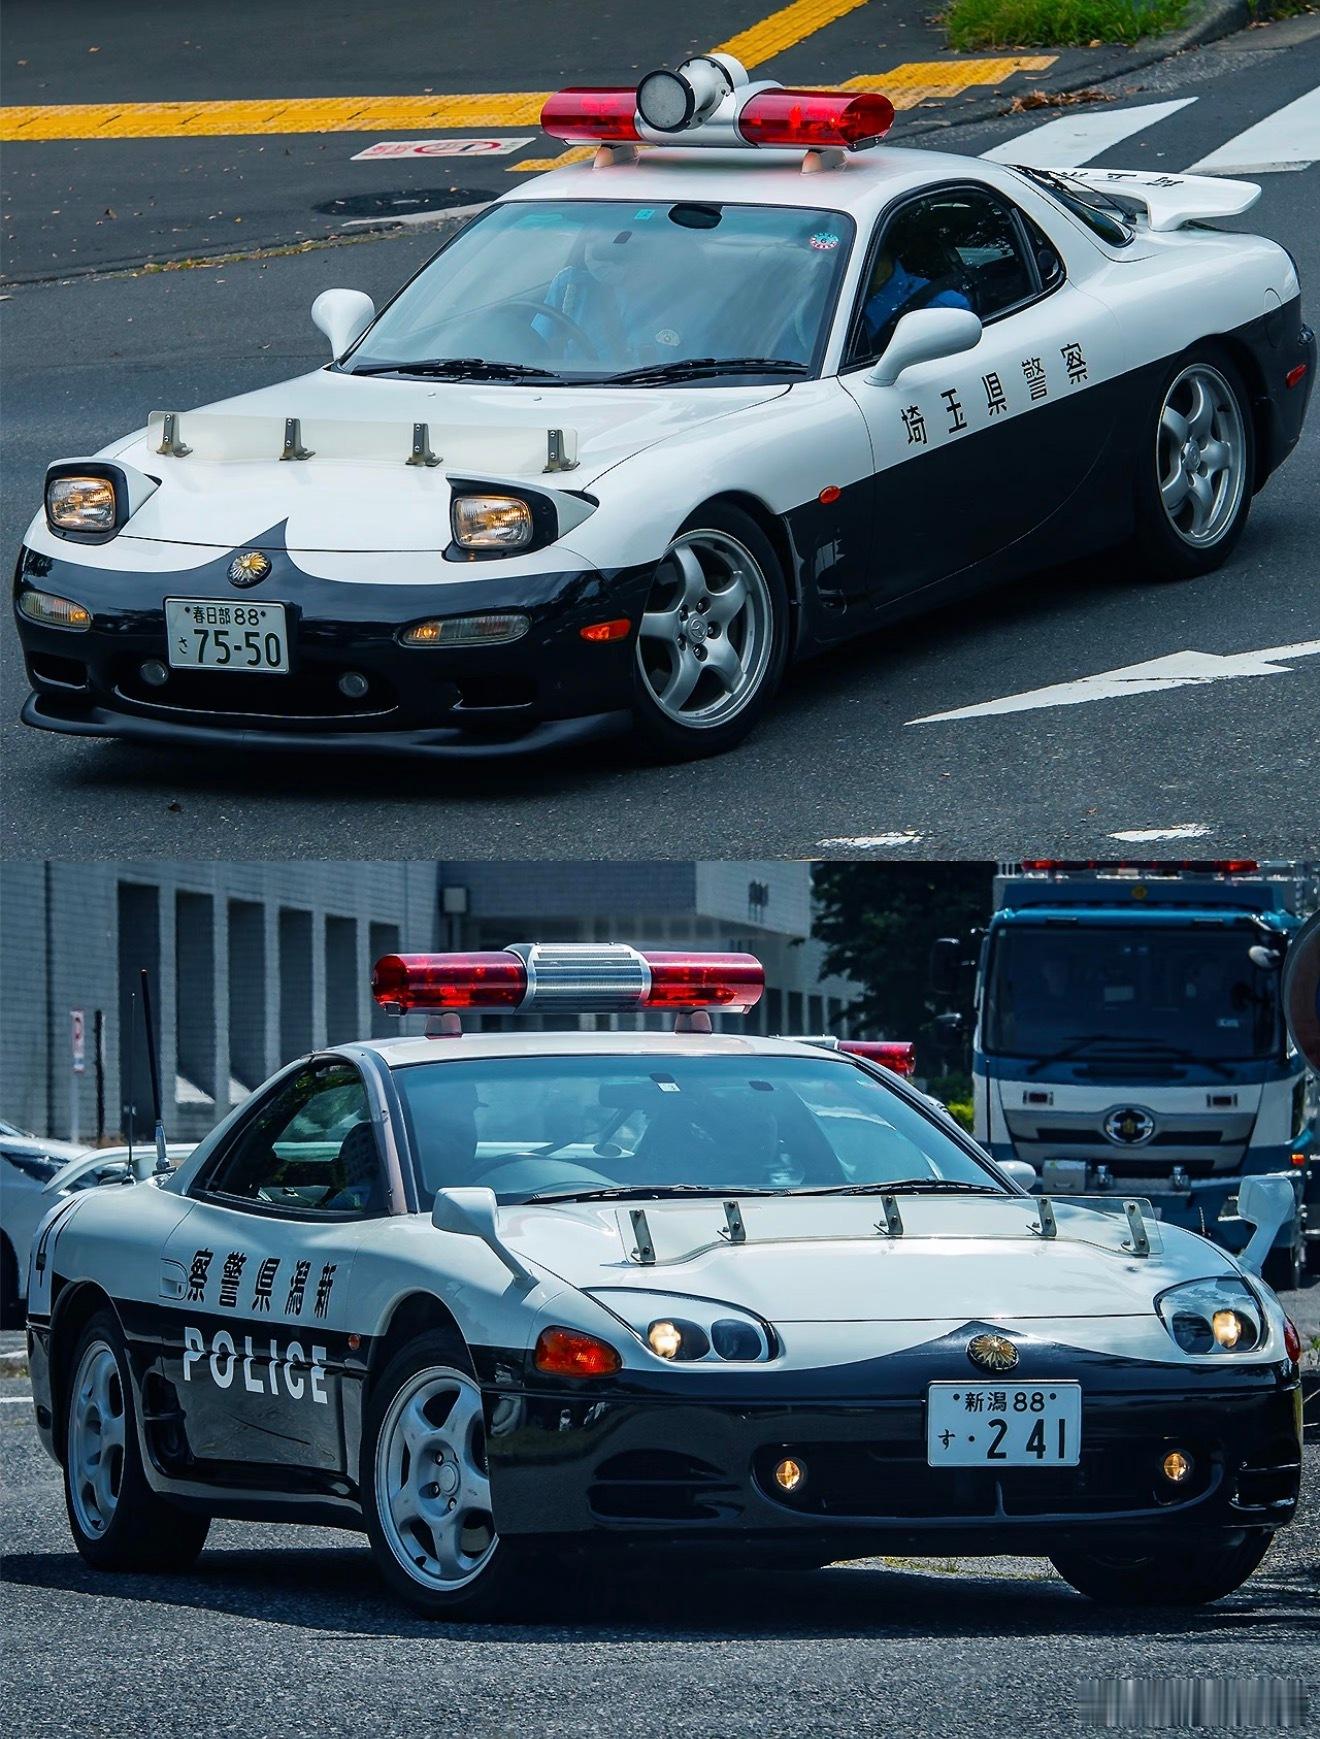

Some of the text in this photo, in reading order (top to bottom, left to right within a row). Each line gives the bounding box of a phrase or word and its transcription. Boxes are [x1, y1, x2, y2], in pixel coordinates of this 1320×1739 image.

[900, 342, 1089, 445] 埼玉県警察
[178, 629, 282, 667] さ 75-50
[183, 1326, 328, 1404] POLICE
[937, 1428, 956, 1450] す
